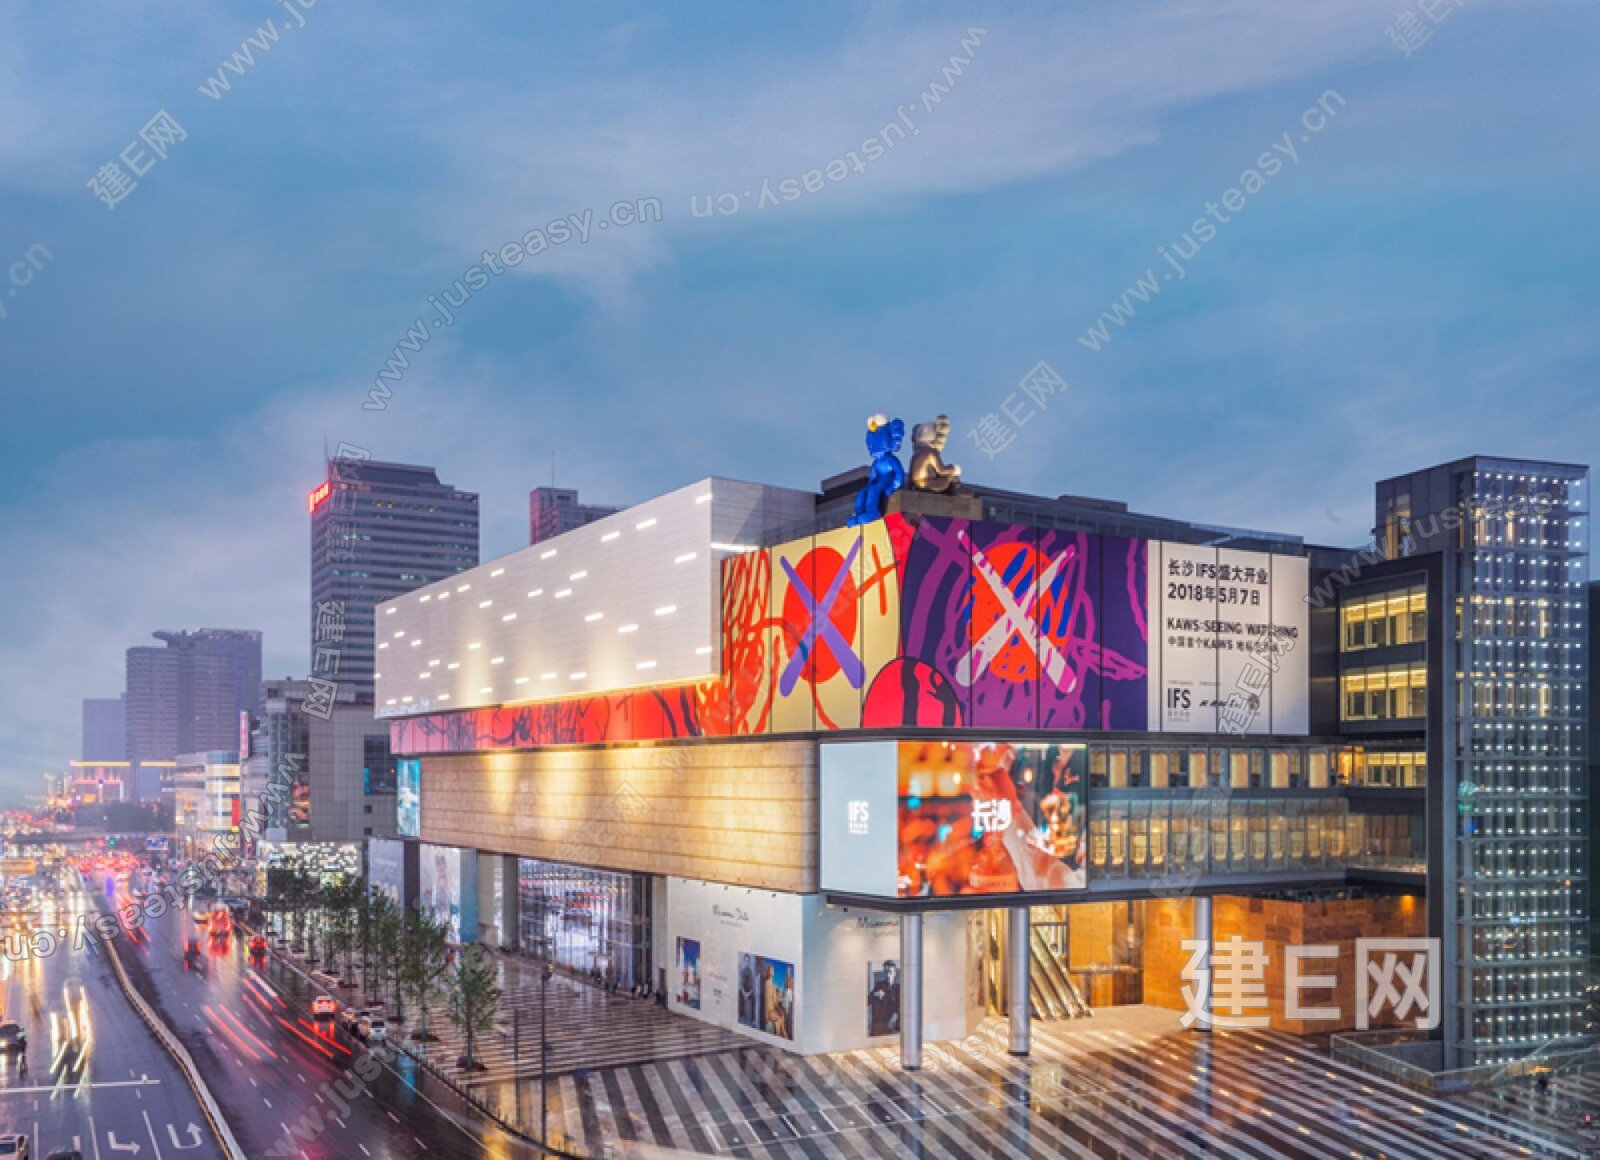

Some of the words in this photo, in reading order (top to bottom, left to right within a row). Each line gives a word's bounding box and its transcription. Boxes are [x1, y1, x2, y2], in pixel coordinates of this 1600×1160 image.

[1167, 582, 1260, 606] 2018年5月7日
[1167, 687, 1191, 709] IFS
